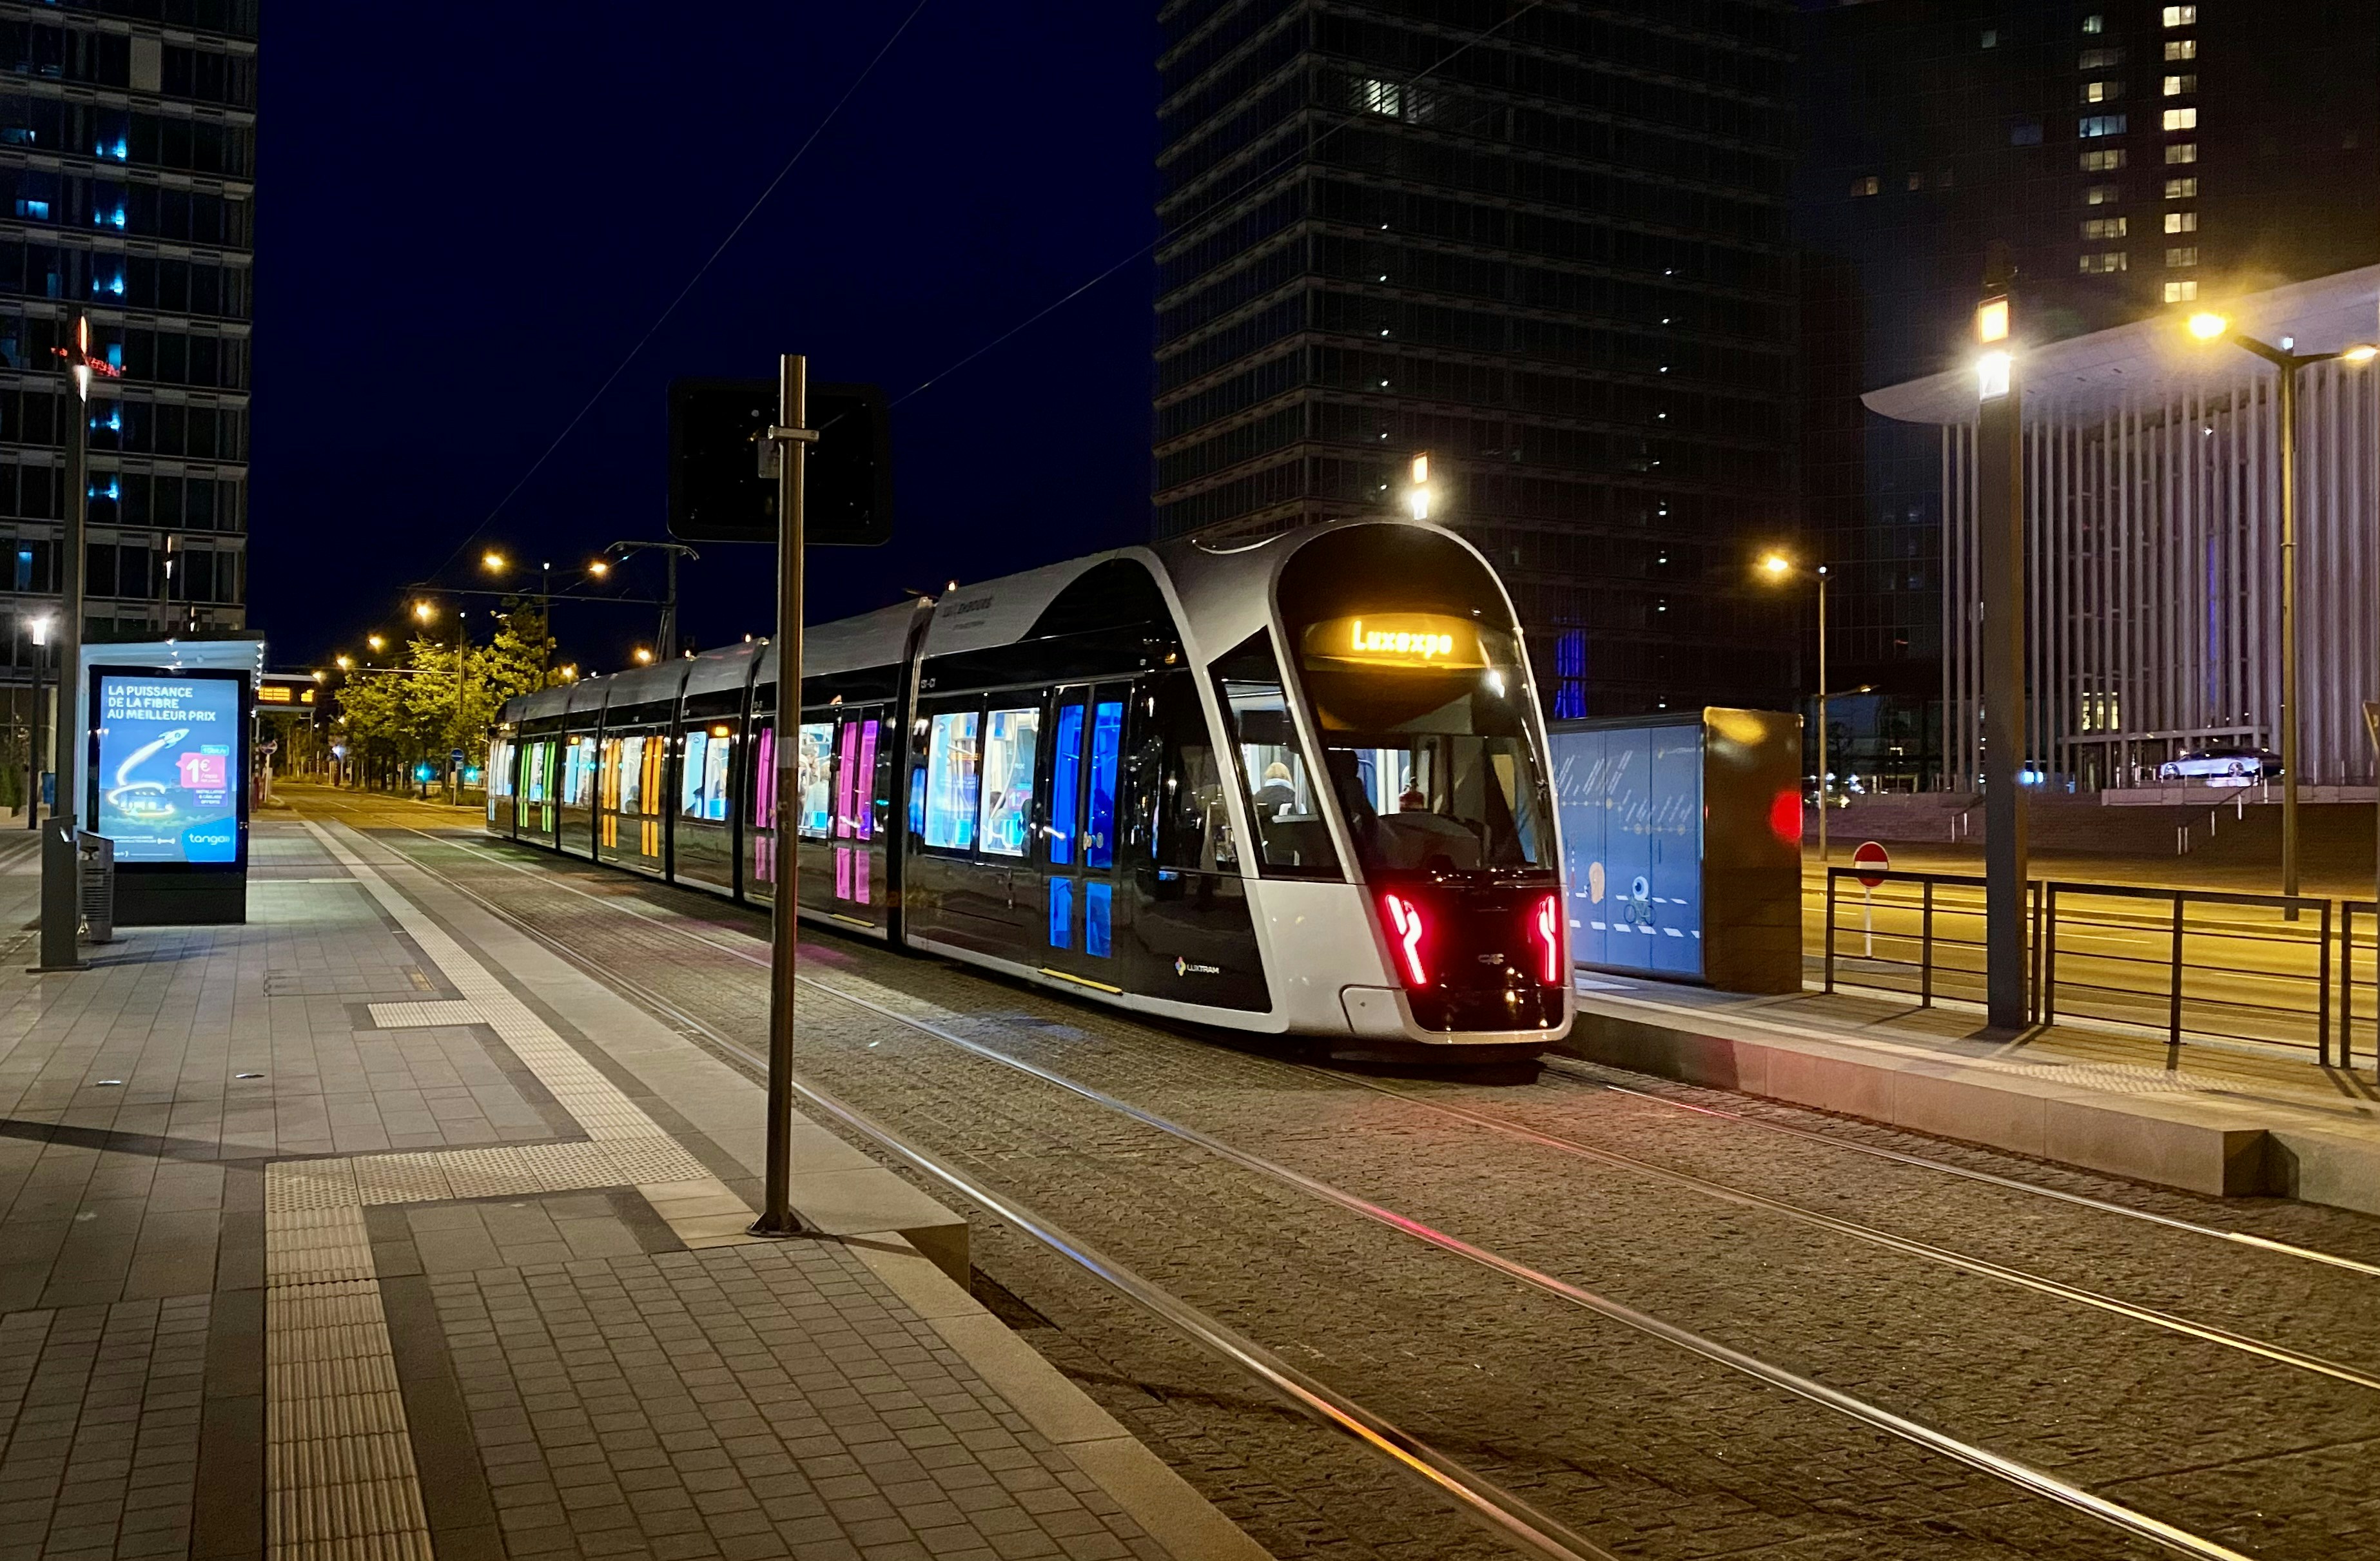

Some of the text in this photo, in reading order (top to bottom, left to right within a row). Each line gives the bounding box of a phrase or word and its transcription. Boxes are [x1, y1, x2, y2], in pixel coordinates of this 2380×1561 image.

[1352, 620, 1452, 659] Luxexpo
[108, 686, 193, 697] LA PUISSANCE
[108, 697, 179, 708] DE LA FIBRE
[107, 709, 216, 721] AU MEILLEUR PRIX
[1187, 964, 1220, 974] LUXTRAM
